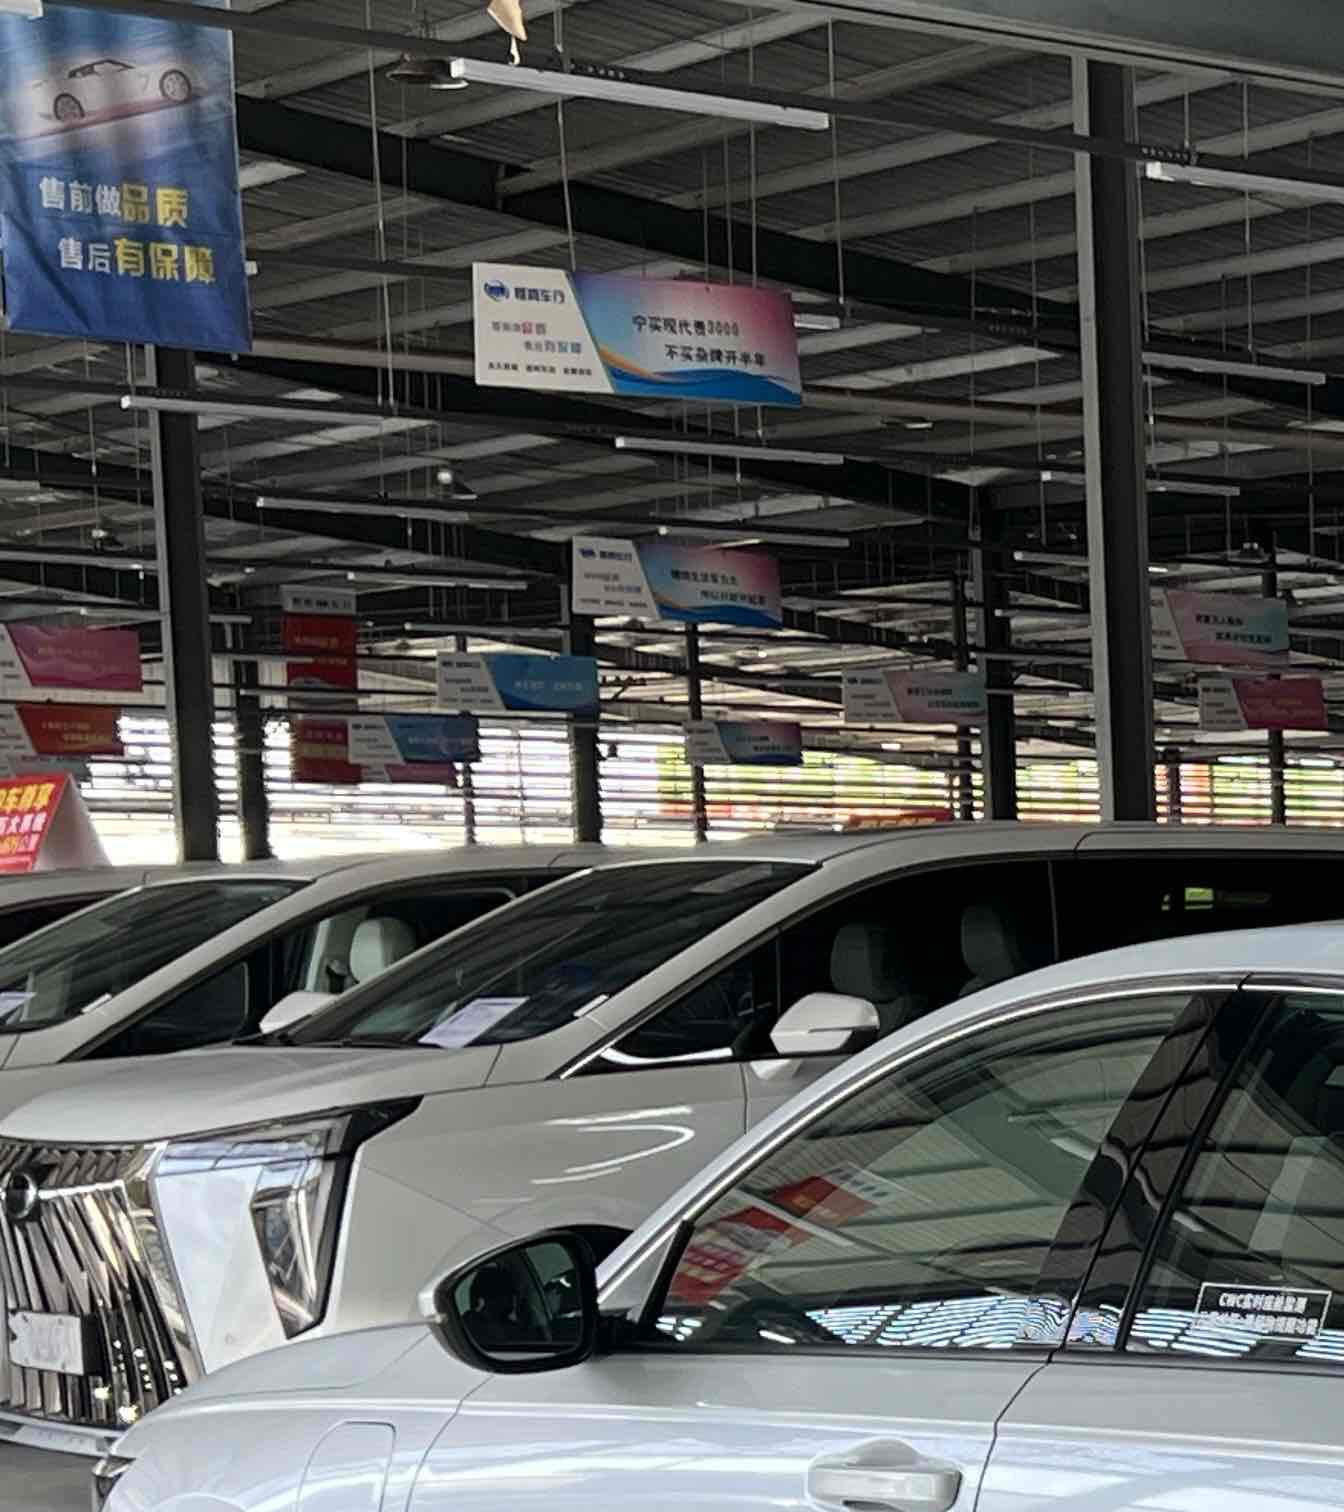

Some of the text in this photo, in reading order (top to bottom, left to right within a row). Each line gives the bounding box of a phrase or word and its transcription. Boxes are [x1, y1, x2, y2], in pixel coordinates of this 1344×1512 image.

[39, 175, 188, 229] 售前做品质
[58, 236, 216, 284] 售后有保障
